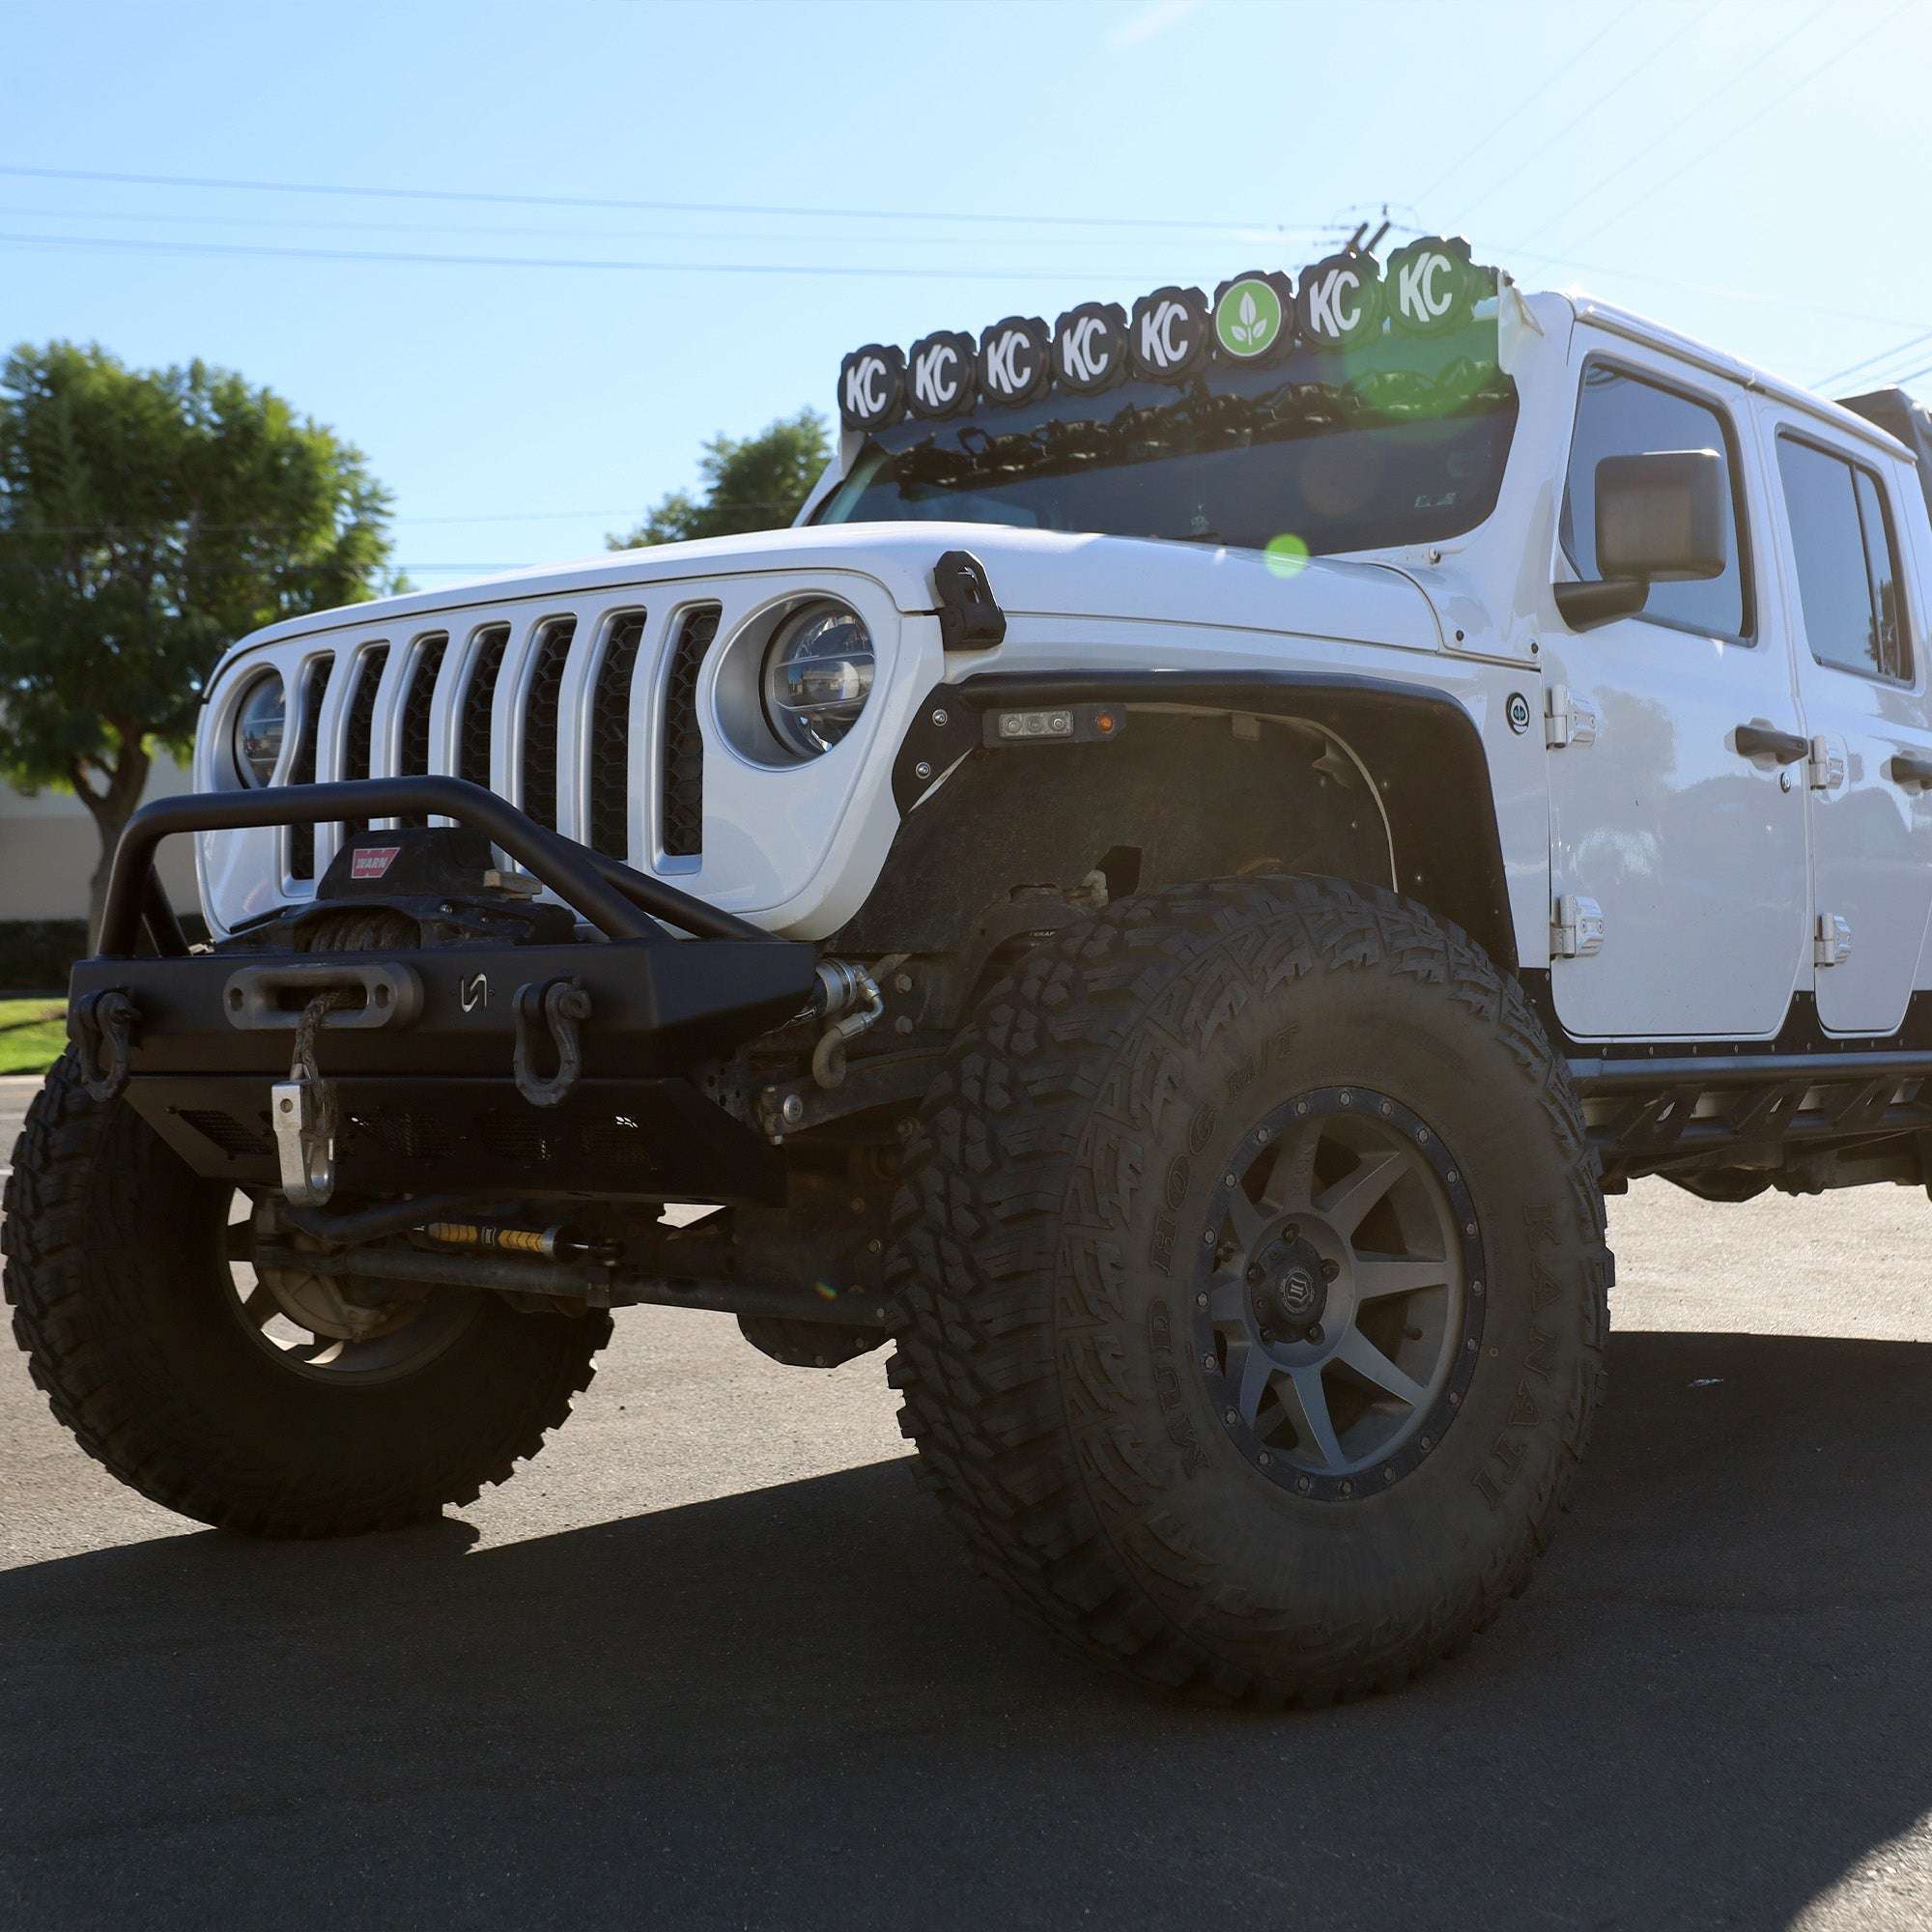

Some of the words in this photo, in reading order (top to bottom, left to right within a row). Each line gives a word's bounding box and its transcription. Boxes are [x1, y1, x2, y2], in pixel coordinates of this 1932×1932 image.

[1309, 270, 1360, 337] KC
[1400, 253, 1452, 322] KC
[987, 330, 1031, 394] KC
[1064, 317, 1109, 381] KC
[1142, 300, 1188, 367] KC
[846, 356, 887, 417] KC
[916, 345, 957, 407] KC
[355, 857, 388, 869] WARN
